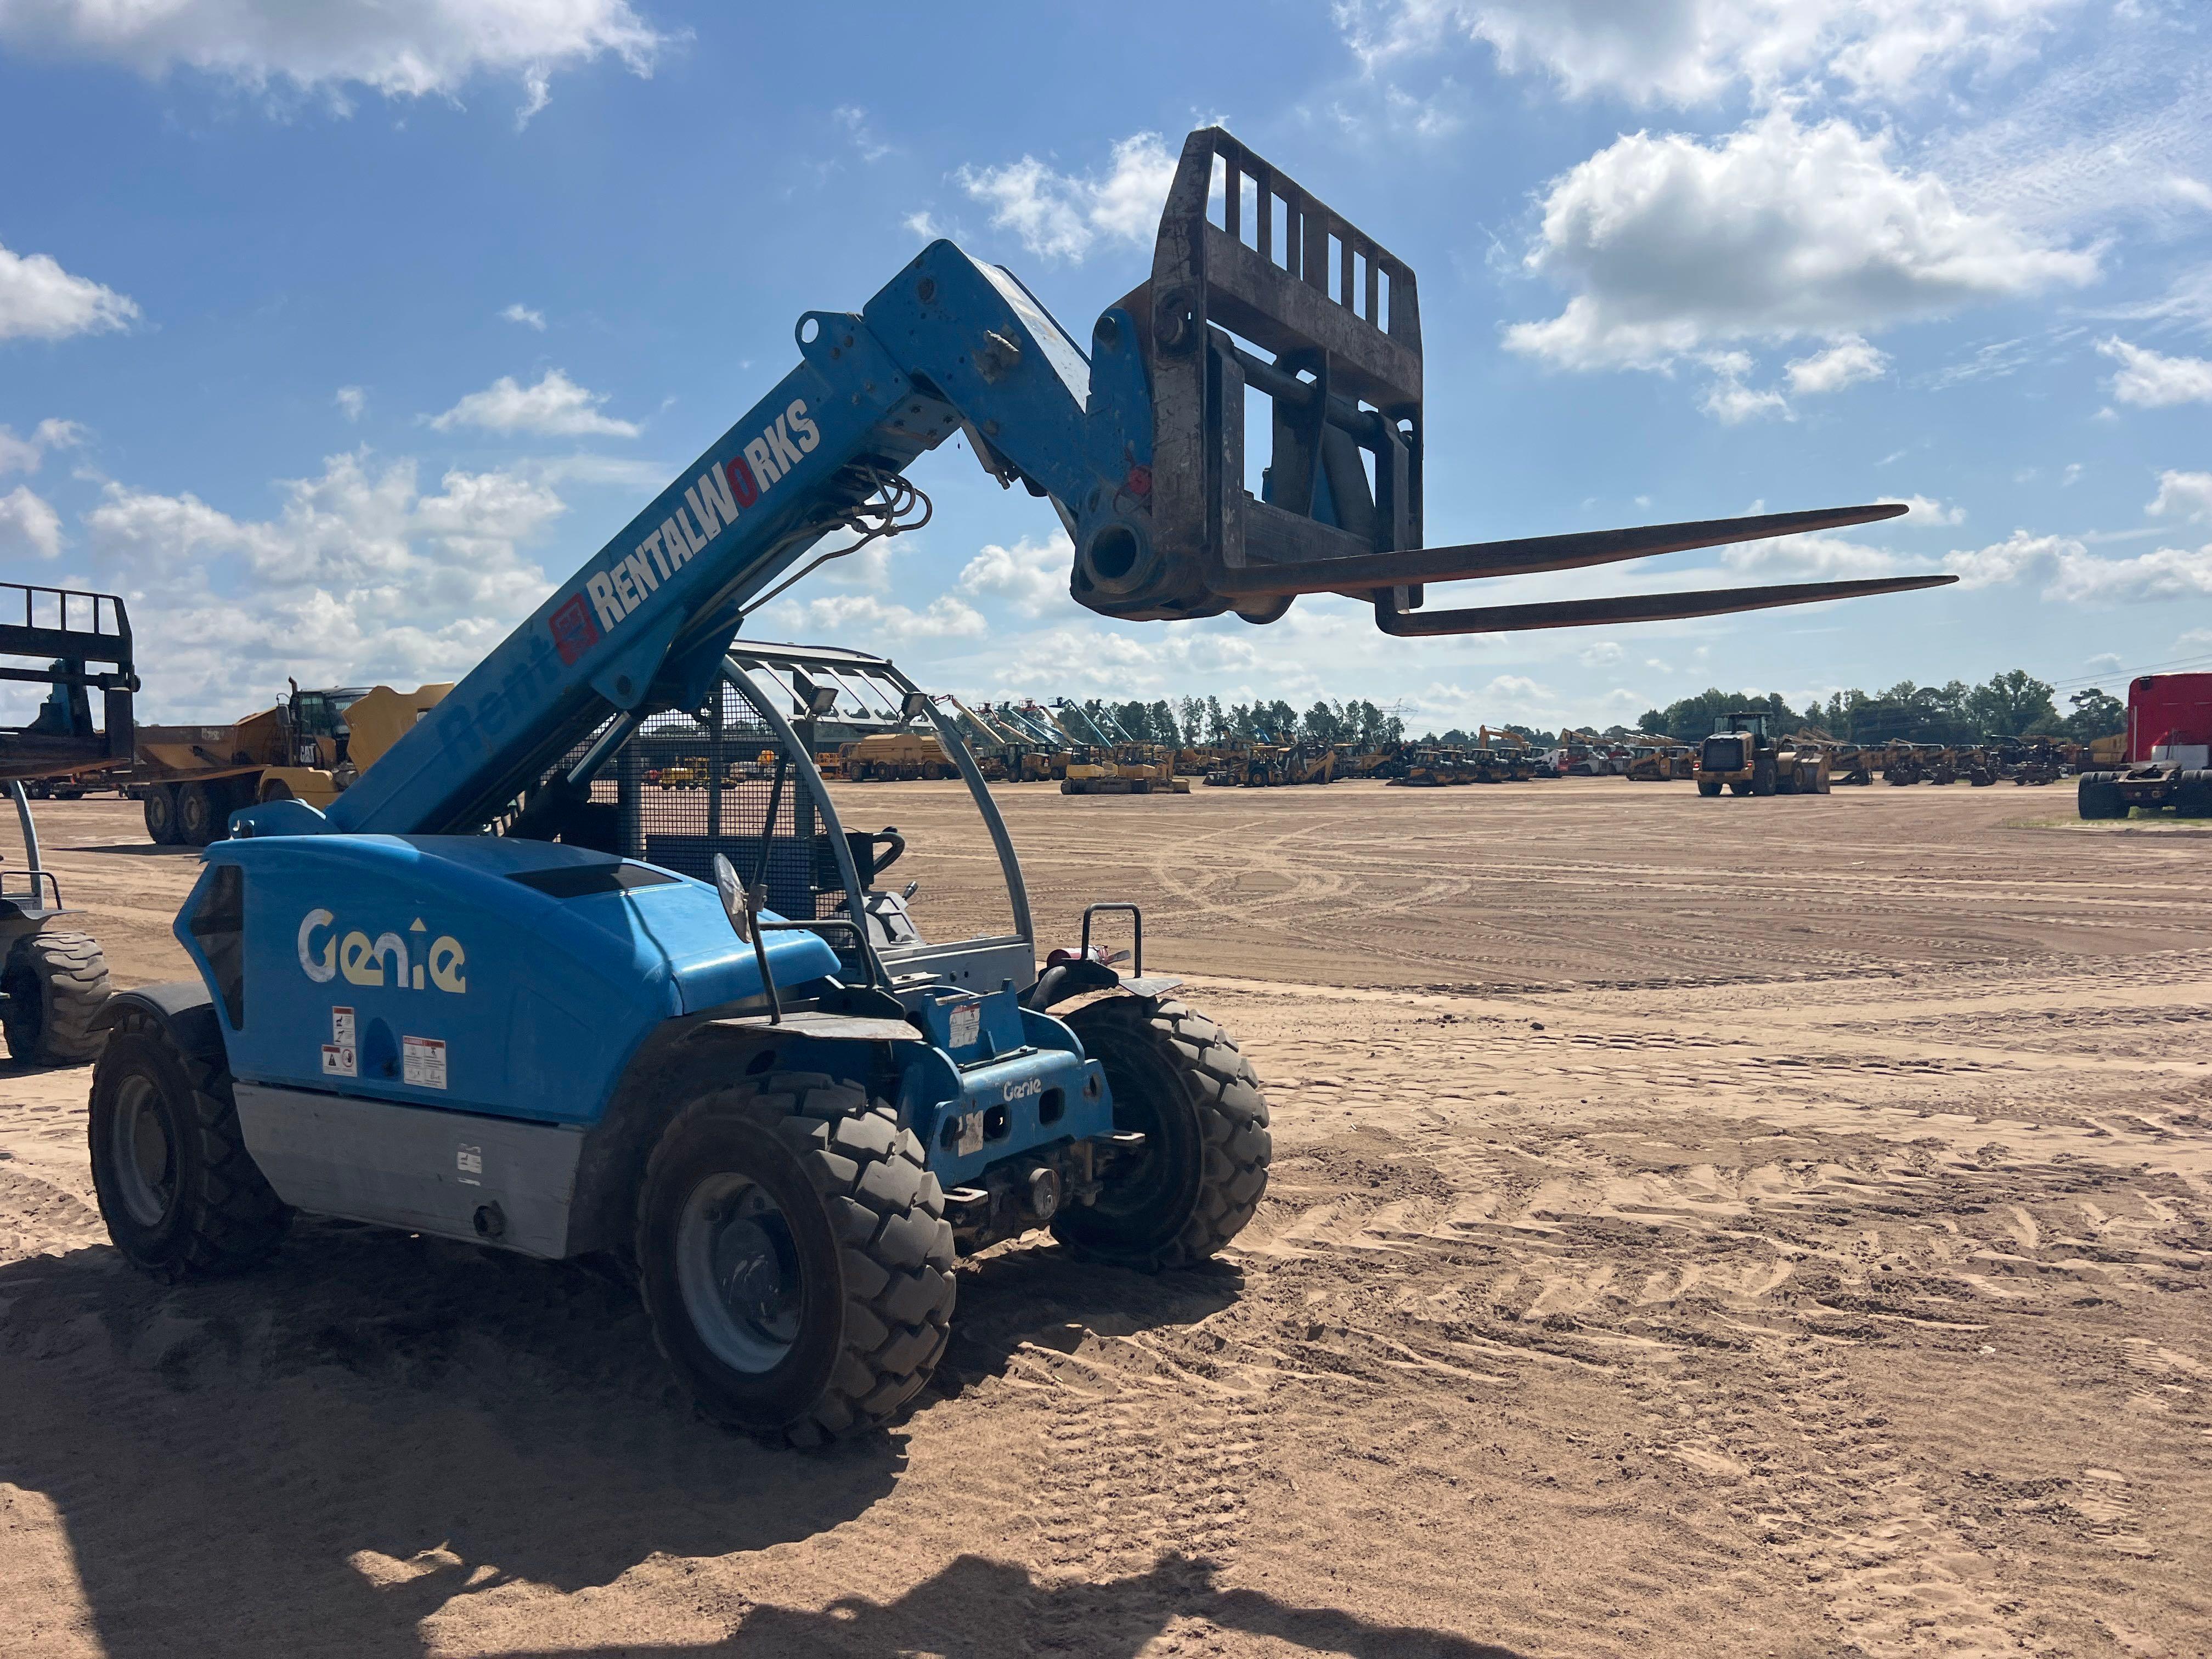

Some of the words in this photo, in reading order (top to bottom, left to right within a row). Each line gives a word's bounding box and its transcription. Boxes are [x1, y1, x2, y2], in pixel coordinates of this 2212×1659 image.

[301, 746, 314, 763] CAT
[298, 909, 466, 994] Genie
[1004, 1077, 1041, 1102] Genie
